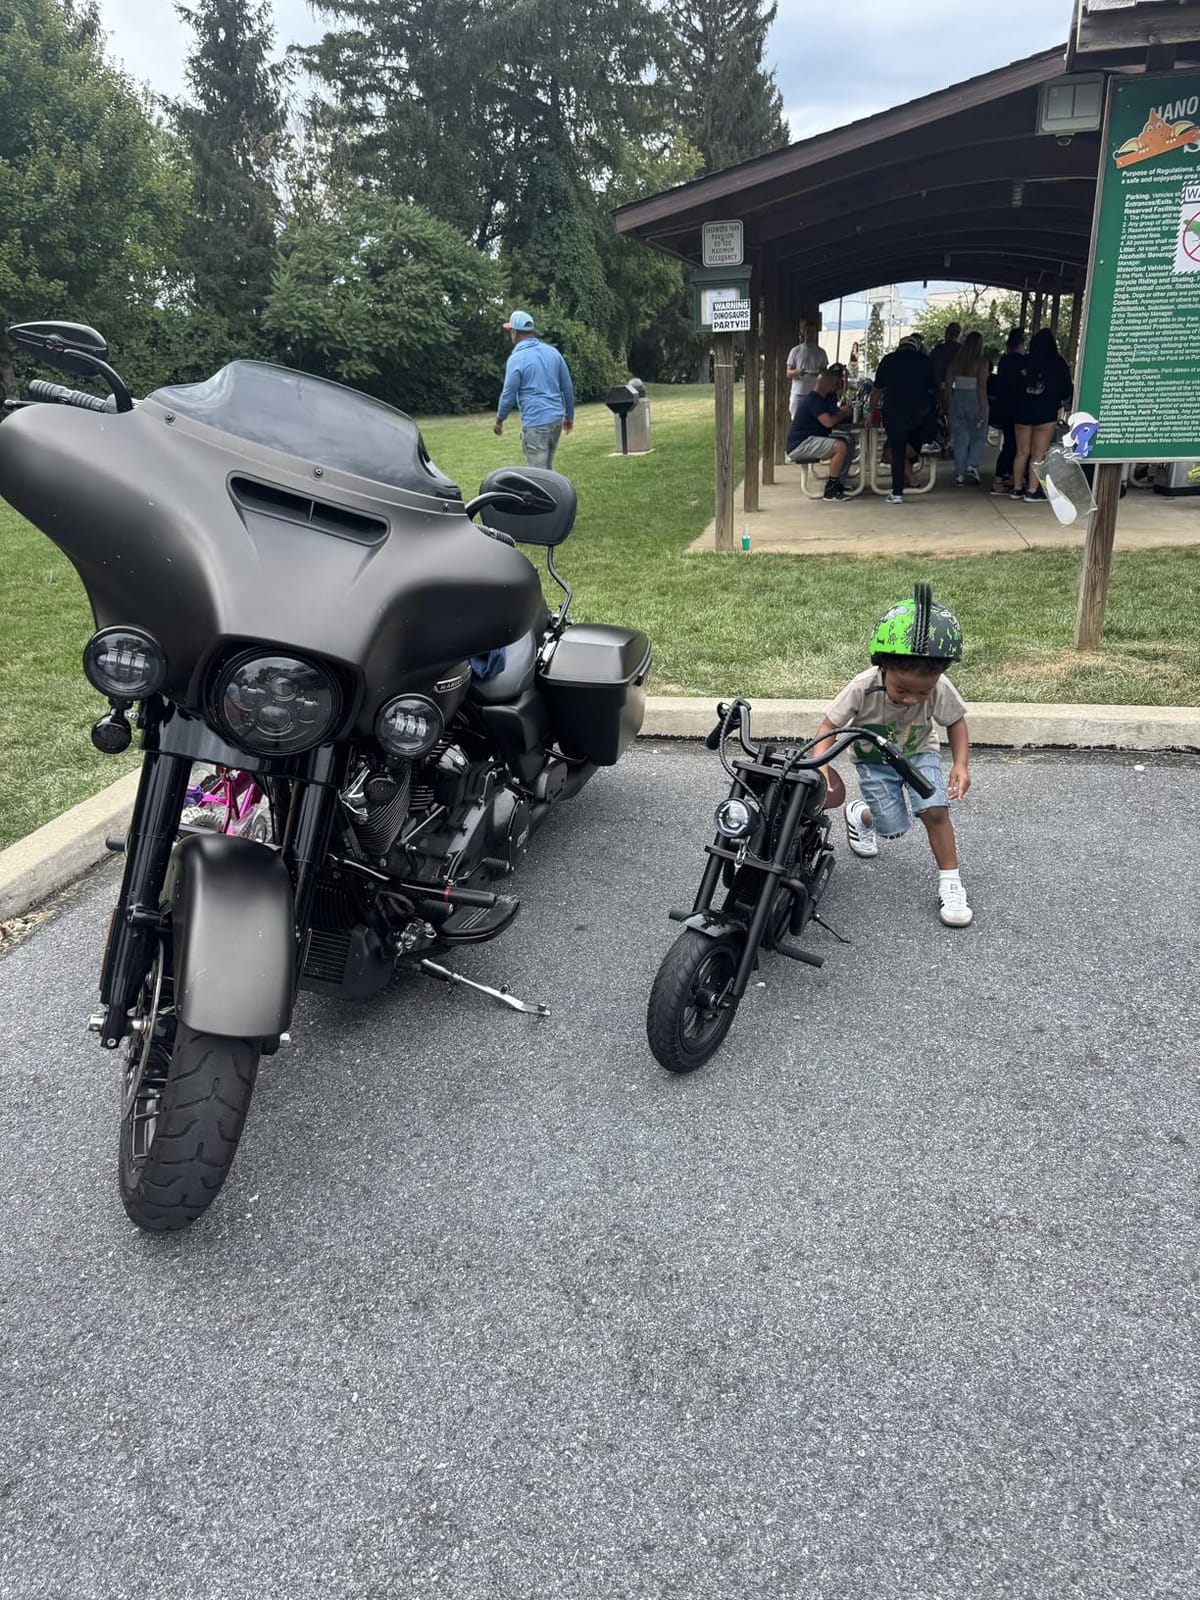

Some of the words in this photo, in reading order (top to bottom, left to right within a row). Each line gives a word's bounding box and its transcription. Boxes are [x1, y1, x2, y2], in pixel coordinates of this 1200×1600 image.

[1122, 170, 1147, 178] Purpose
[1156, 166, 1194, 176] Regulations.
[1153, 174, 1183, 183] enjoyable
[1125, 198, 1172, 207] Entrances/Exits.
[714, 302, 748, 310] WARNING
[714, 311, 748, 320] DINOSAURS
[714, 320, 748, 329] PARTY!!!
